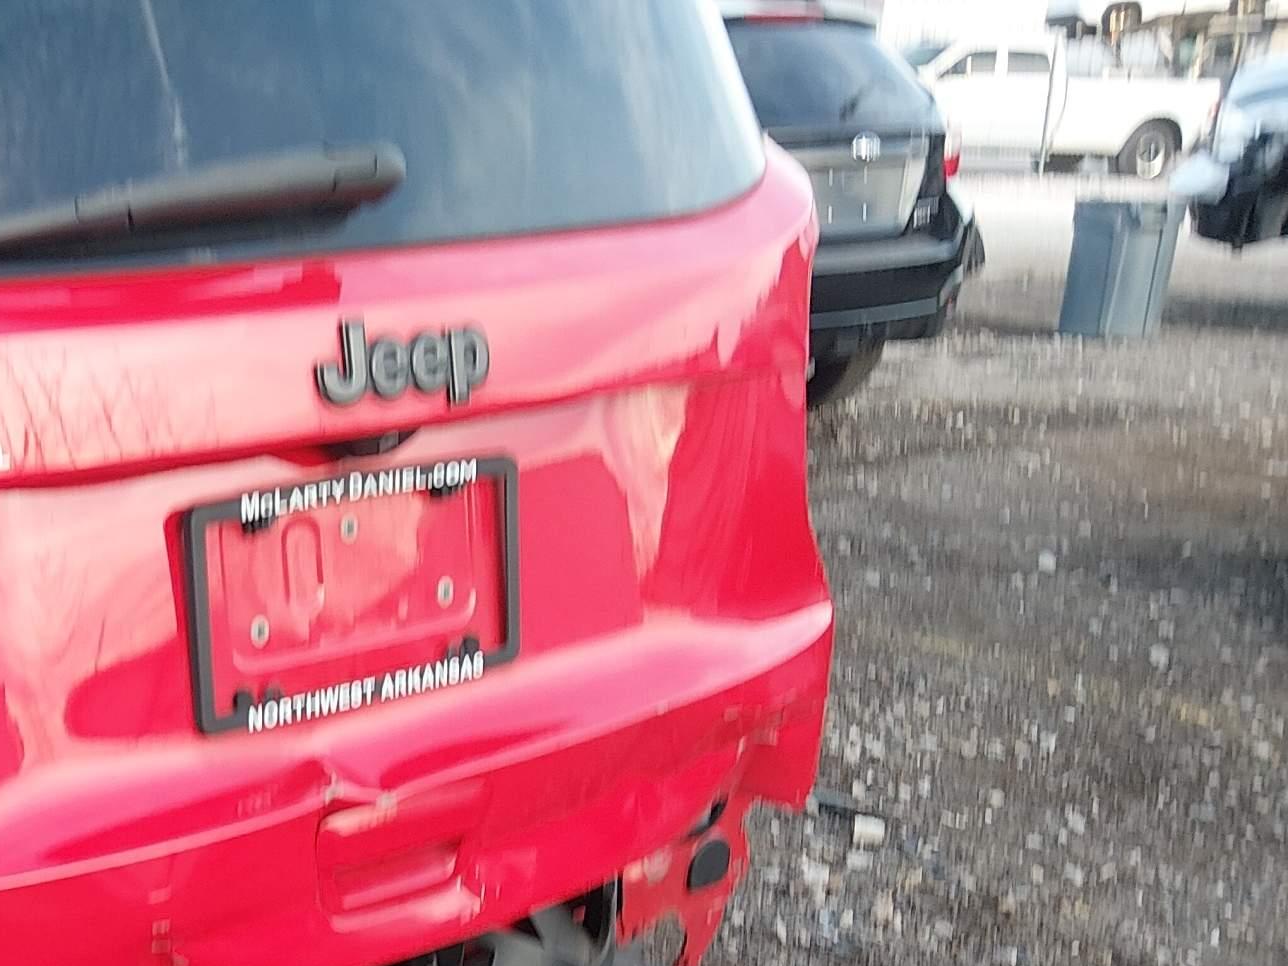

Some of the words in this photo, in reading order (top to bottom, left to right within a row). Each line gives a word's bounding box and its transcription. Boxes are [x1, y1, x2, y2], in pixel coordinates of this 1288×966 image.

[314, 316, 490, 408] Jeep
[247, 676, 376, 733] NORTHWEST
[380, 650, 485, 702] ARKANSAS
